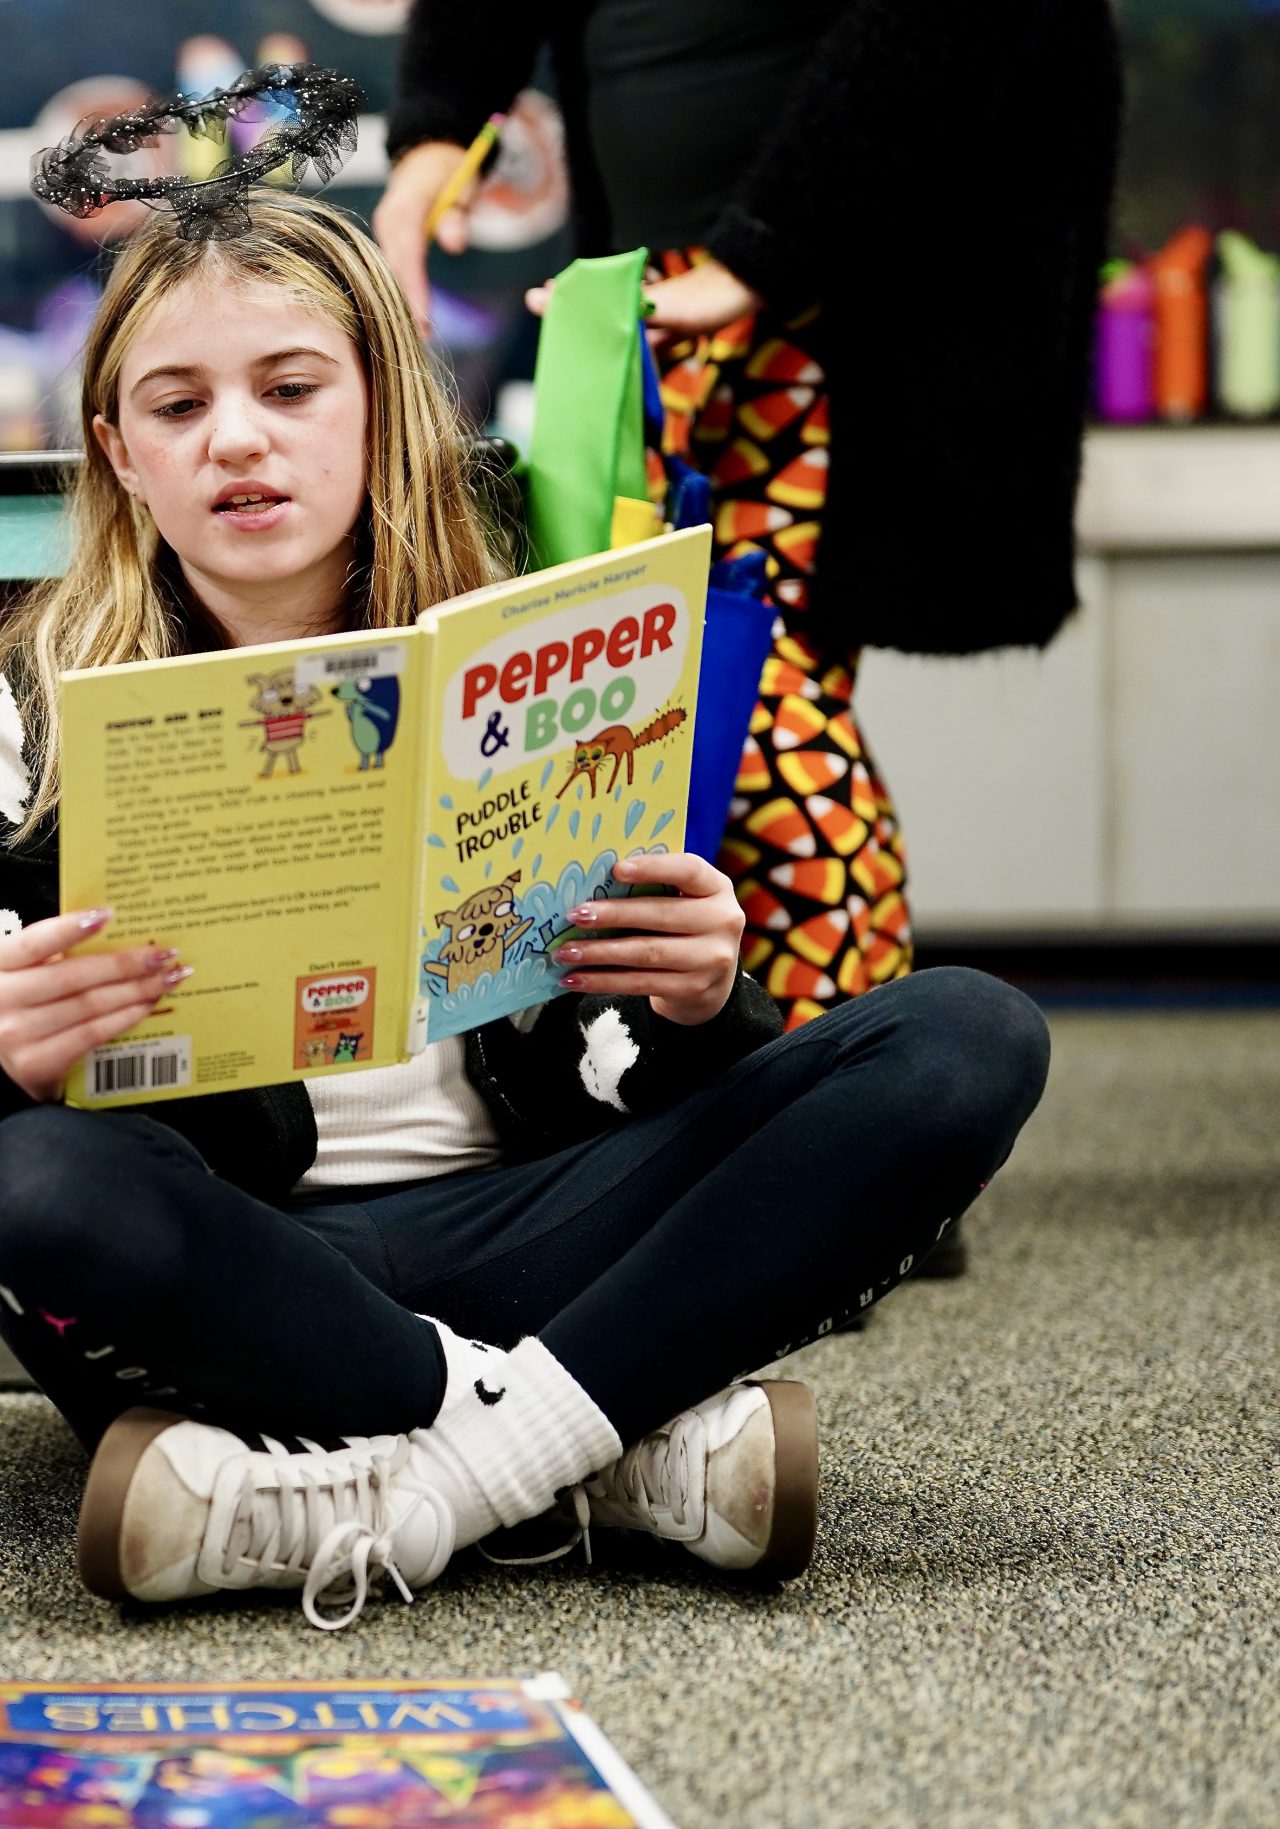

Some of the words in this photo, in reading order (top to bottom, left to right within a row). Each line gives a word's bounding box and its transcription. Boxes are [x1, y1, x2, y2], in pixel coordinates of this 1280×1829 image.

[481, 711, 509, 757] &
[524, 675, 636, 753] BOO
[456, 780, 531, 836] PUDDLE
[456, 802, 542, 863] TROUBLE
[43, 1701, 473, 1732] WITCHES
